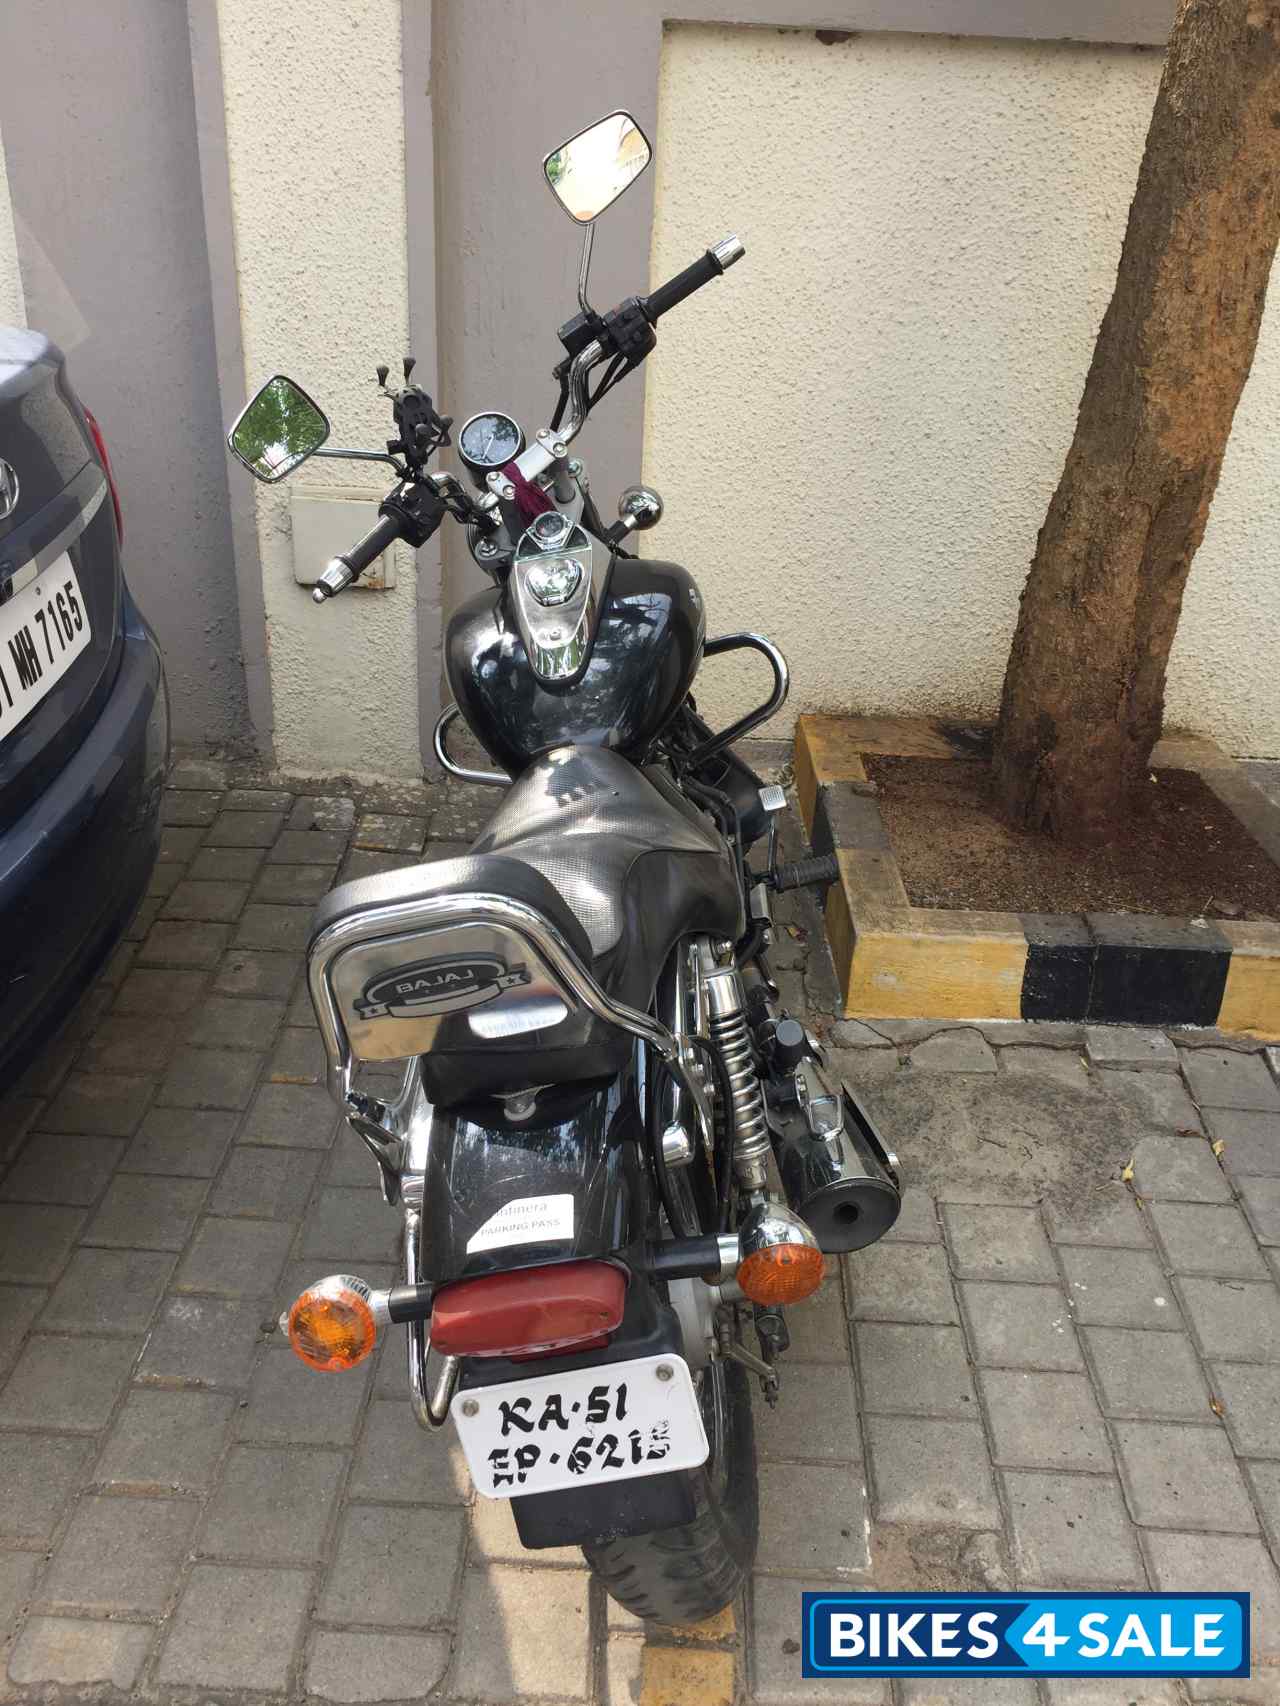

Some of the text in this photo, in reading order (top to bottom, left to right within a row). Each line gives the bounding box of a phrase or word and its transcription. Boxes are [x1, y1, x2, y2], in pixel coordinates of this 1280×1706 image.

[8, 625, 42, 690] MH
[34, 581, 83, 665] 7165
[395, 969, 474, 994] BAJAJ
[532, 1218, 561, 1230] PASS
